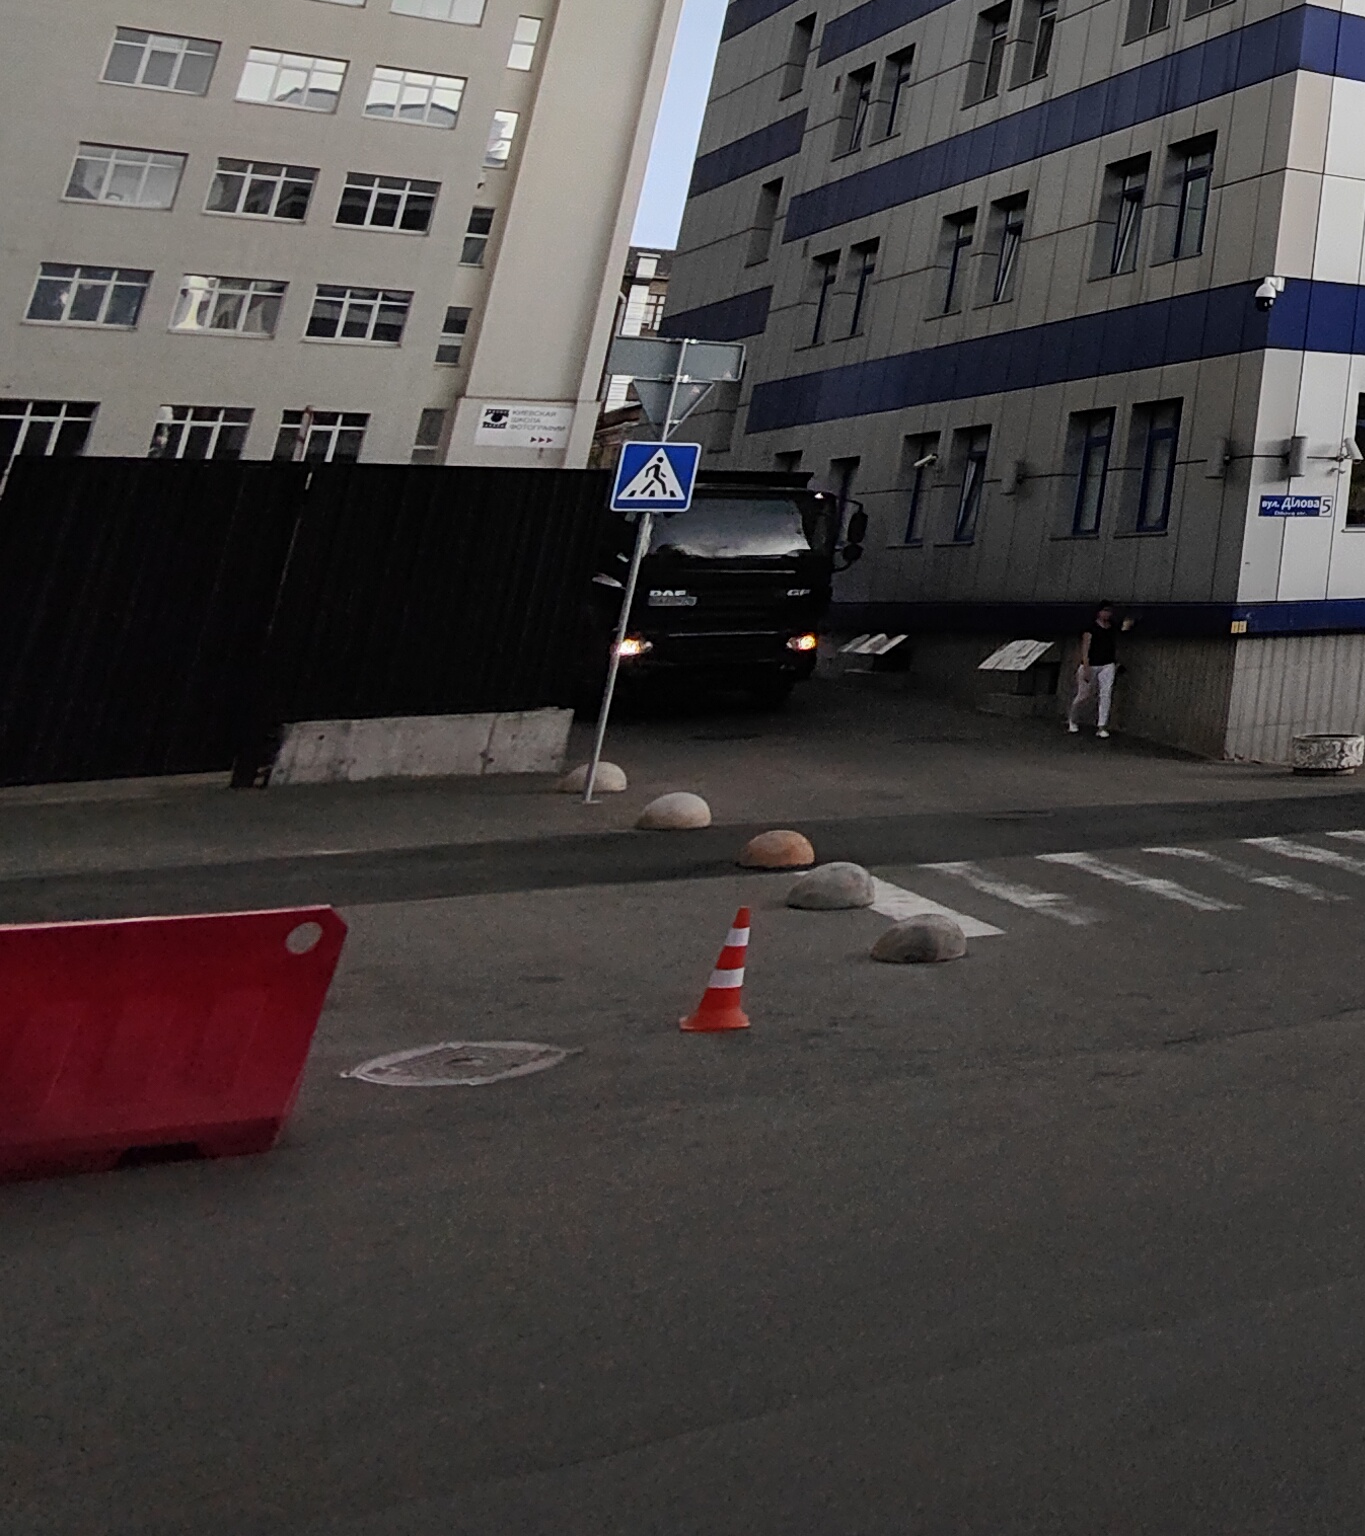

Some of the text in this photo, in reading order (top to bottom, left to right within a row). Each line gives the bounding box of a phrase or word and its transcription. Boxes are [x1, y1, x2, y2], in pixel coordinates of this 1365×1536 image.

[1262, 497, 1331, 513] вул. Ділова 5
